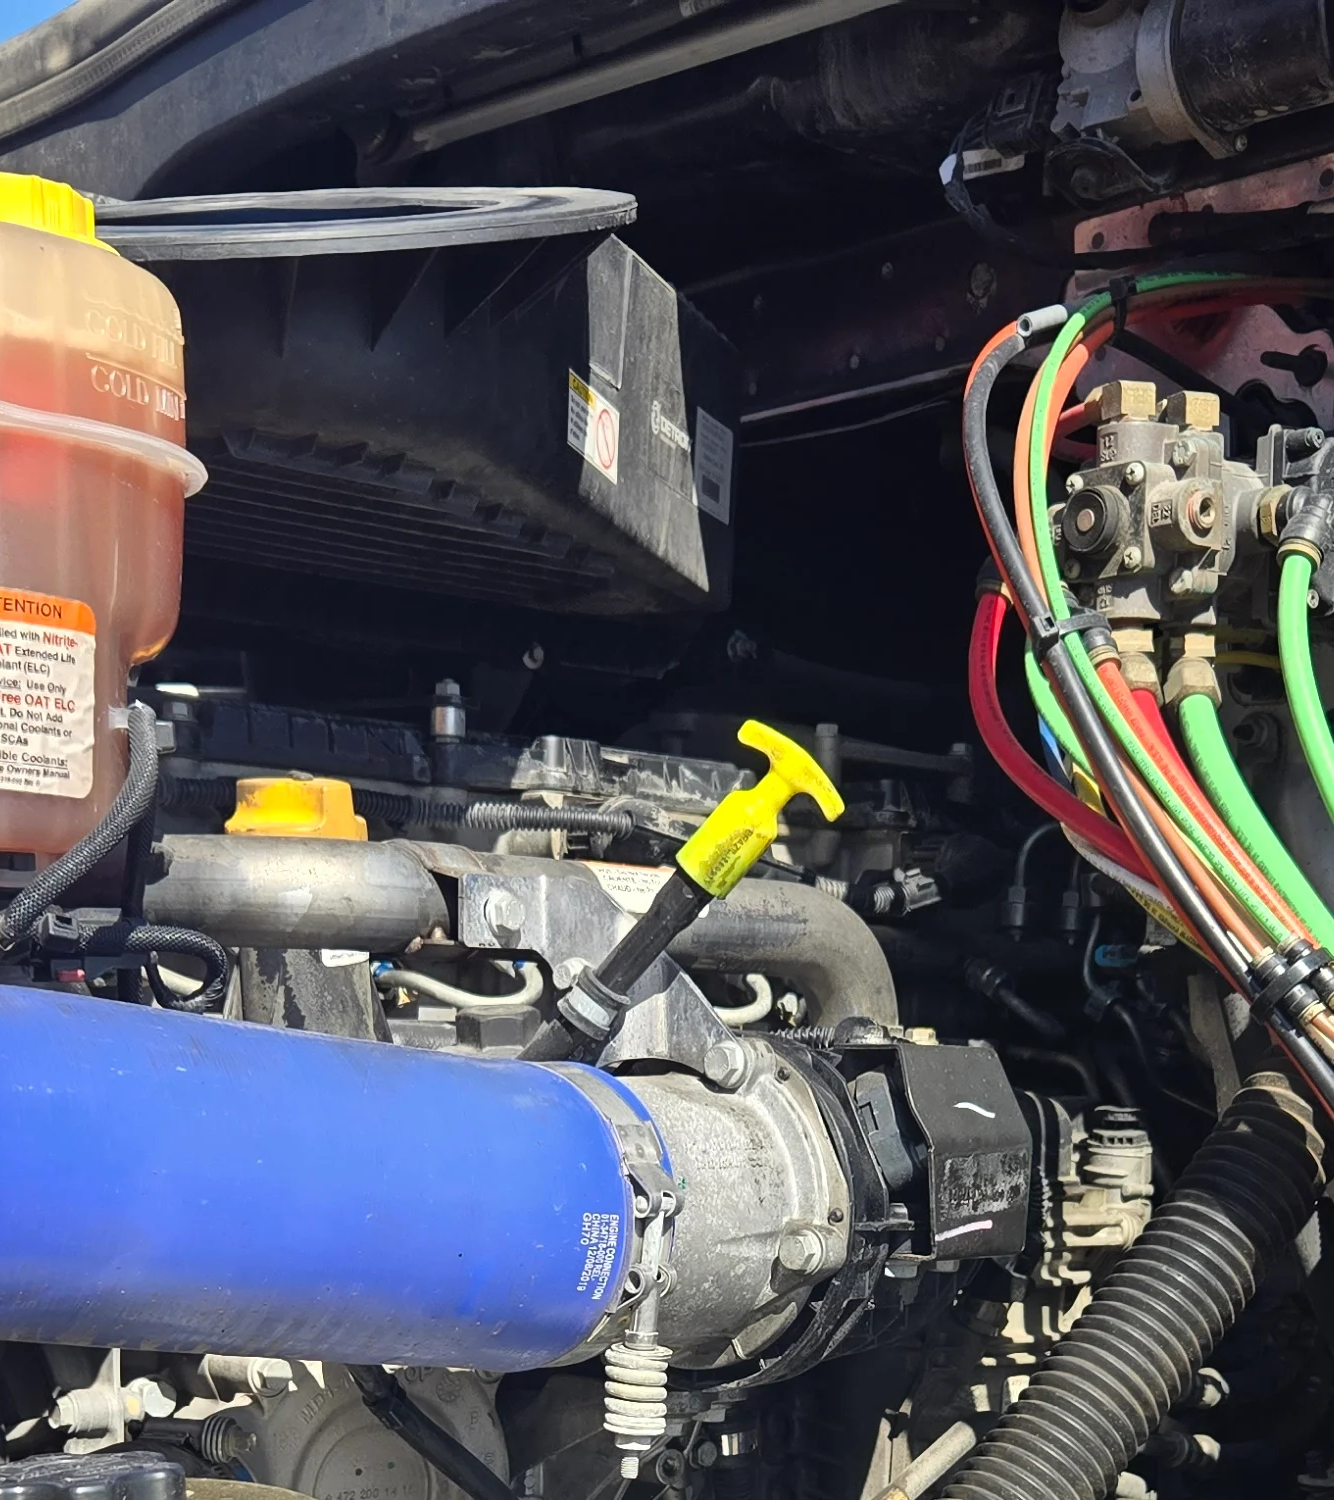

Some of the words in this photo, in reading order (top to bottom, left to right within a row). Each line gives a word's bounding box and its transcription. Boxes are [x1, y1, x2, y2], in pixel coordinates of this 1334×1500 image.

[91, 364, 149, 405] COLD
[20, 629, 41, 642] with
[43, 632, 79, 648] Nitrite-
[15, 646, 59, 662] Extended
[60, 653, 76, 664] Life
[23, 662, 51, 677] (ELC)
[26, 679, 45, 691] Use
[47, 682, 67, 696] Only
[24, 694, 52, 709] OAT
[54, 699, 76, 713] ELC
[9, 708, 24, 718] Do
[26, 710, 43, 722] Not
[46, 712, 63, 724] Add
[21, 722, 61, 737] Coolants
[63, 728, 73, 738] or
[0, 734, 29, 746] SCAs
[21, 752, 68, 768] Coolants:
[580, 1212, 593, 1246] GH70
[589, 1213, 601, 1245] CHINA
[607, 1214, 620, 1247] ENGINE
[591, 1248, 617, 1300] CONNECTION
[359, 1488, 380, 1499] 200
